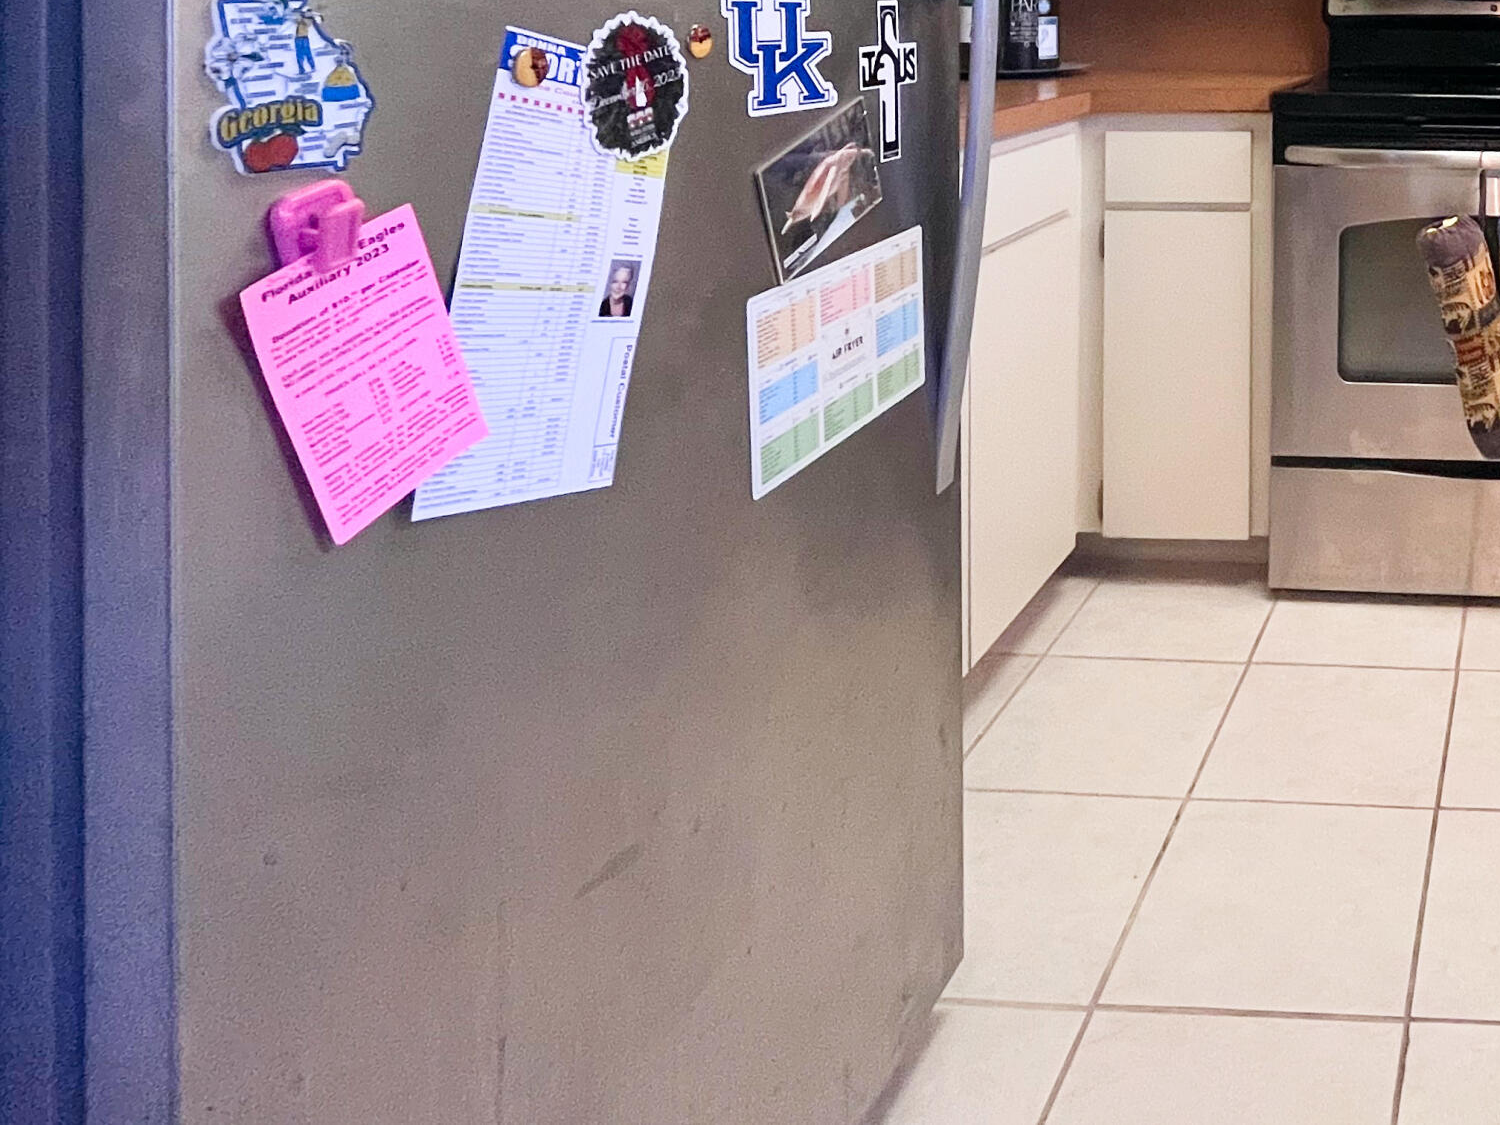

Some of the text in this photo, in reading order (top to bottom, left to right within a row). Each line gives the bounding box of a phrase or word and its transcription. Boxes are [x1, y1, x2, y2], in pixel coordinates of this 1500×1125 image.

[620, 54, 642, 71] THE
[643, 45, 670, 63] DATE
[209, 100, 319, 142] Georgia
[261, 222, 405, 303] Florida Eagles
[288, 243, 390, 305] Auxiliary 2023
